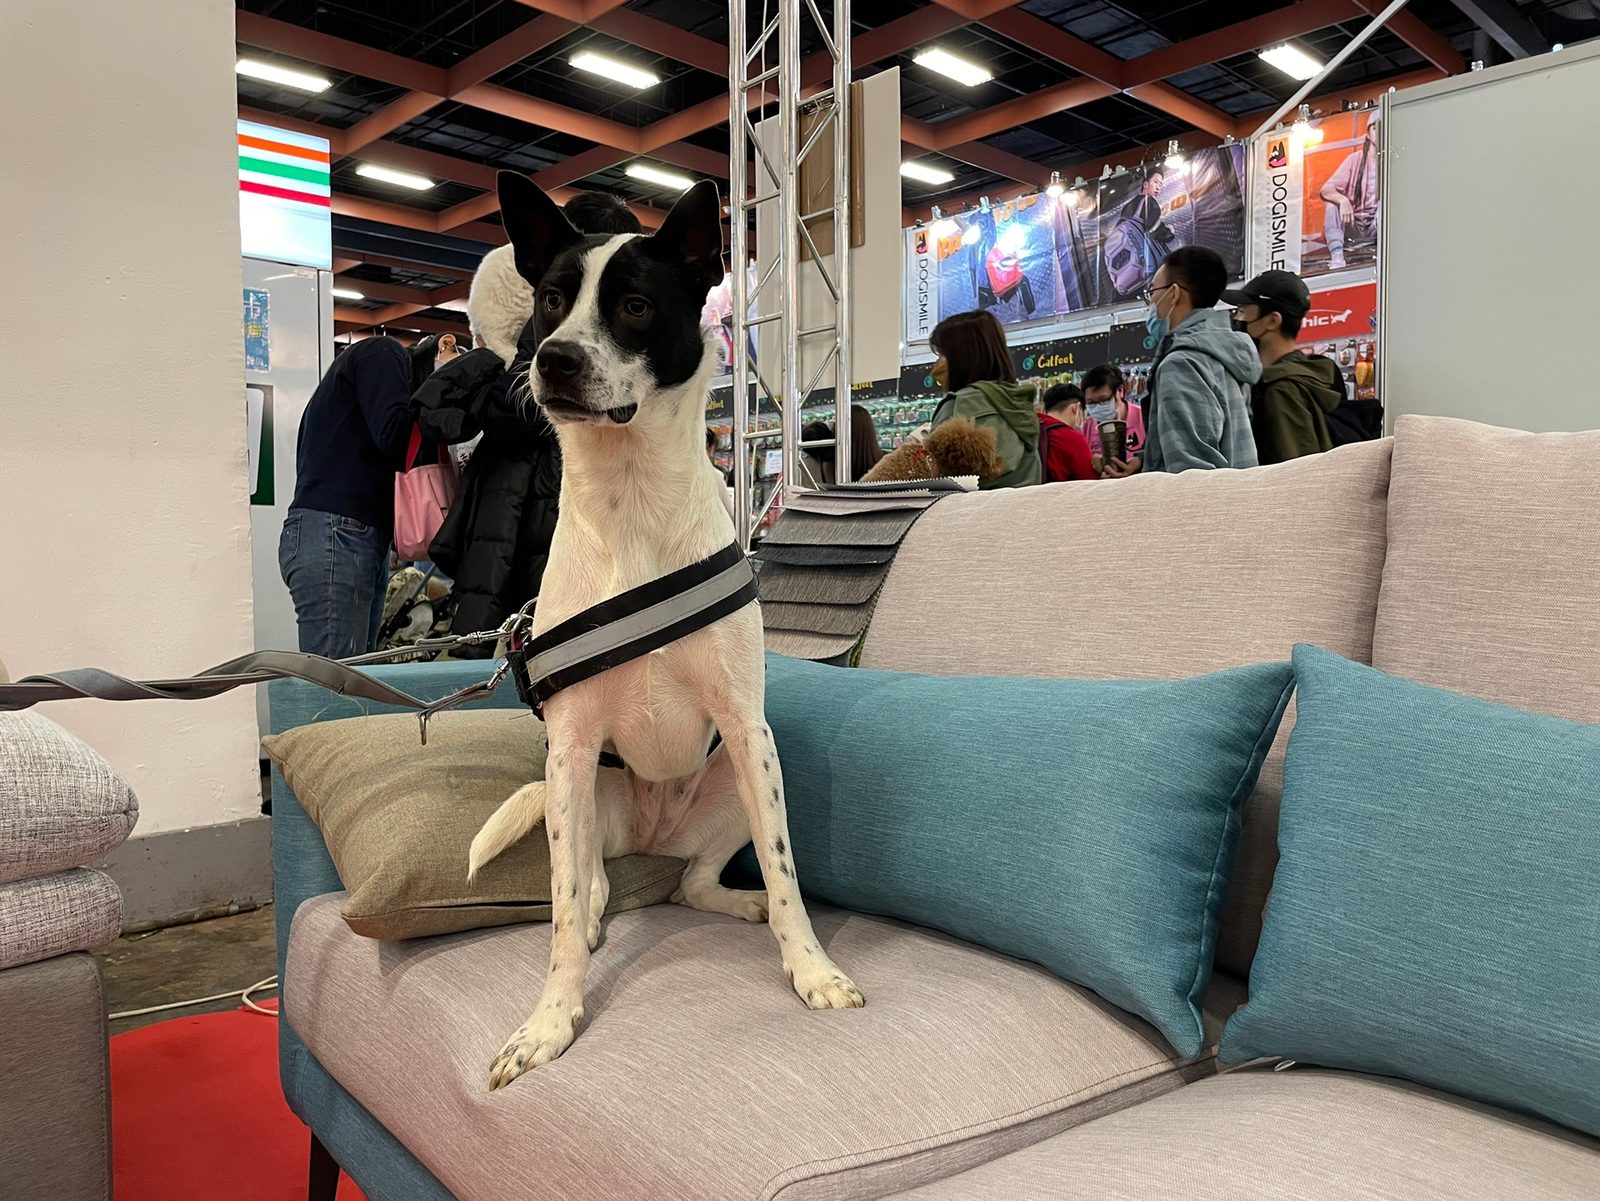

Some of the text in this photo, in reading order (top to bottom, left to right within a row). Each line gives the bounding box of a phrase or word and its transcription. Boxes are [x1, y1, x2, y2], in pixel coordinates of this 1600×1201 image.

[1270, 173, 1288, 270] DOGISMILE
[918, 258, 929, 335] DOGISMILE
[1302, 315, 1329, 328] hic
